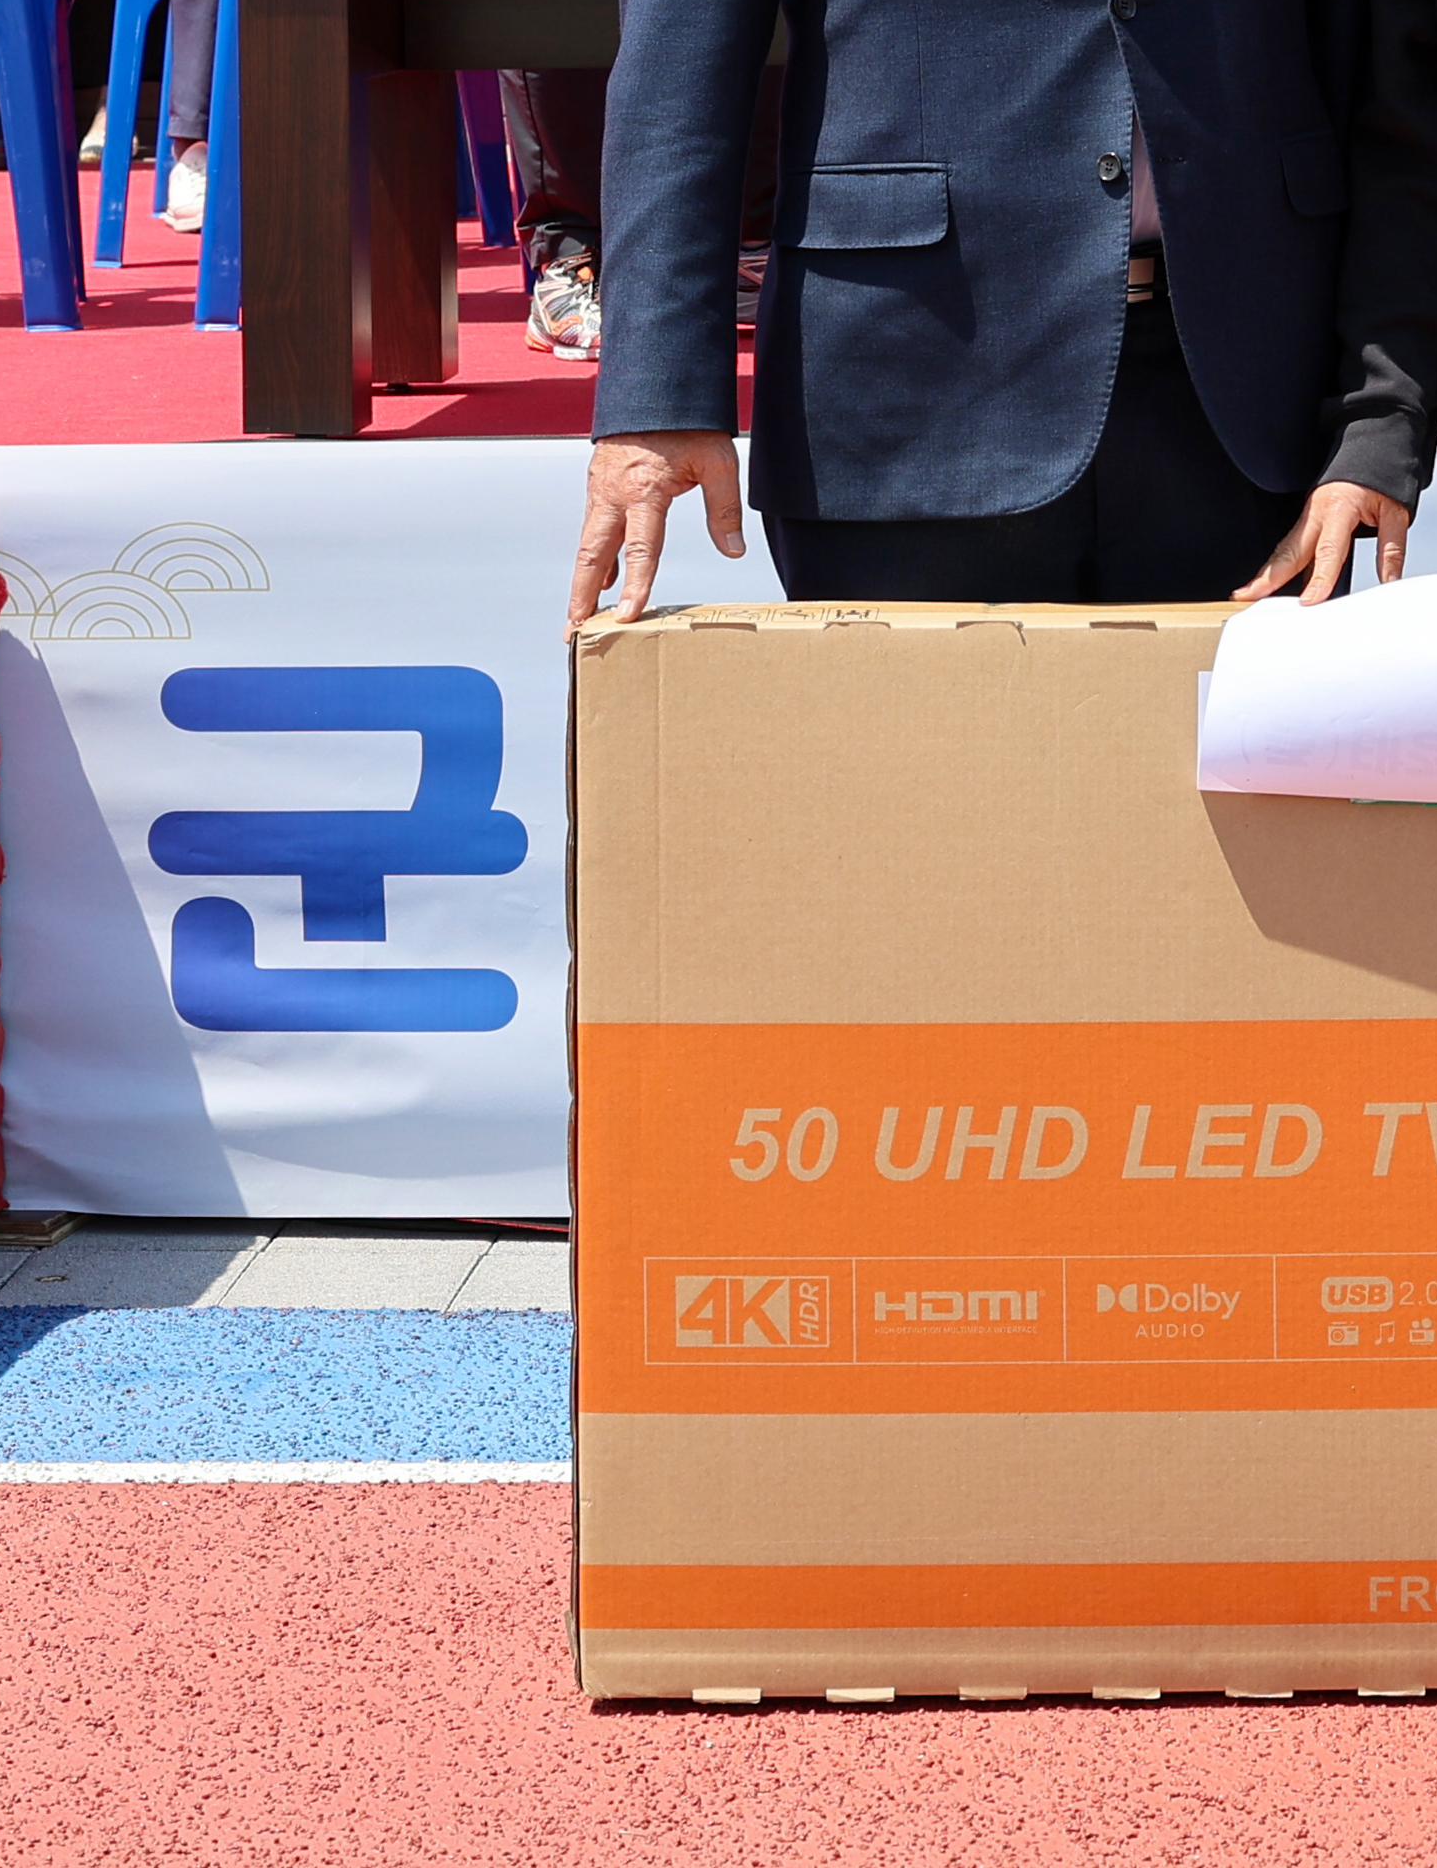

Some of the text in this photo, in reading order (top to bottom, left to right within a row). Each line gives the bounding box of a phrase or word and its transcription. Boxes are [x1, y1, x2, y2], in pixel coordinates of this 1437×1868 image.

[730, 1107, 838, 1181] 50
[875, 1106, 1088, 1181] UHD
[1122, 1104, 1323, 1178] LED
[676, 1277, 791, 1345] 4K
[797, 1281, 822, 1342] HDR
[875, 1291, 1037, 1321] HDMI
[1143, 1282, 1241, 1320] Dolby
[1327, 1283, 1389, 1306] USB
[1135, 1324, 1204, 1338] AUDIO
